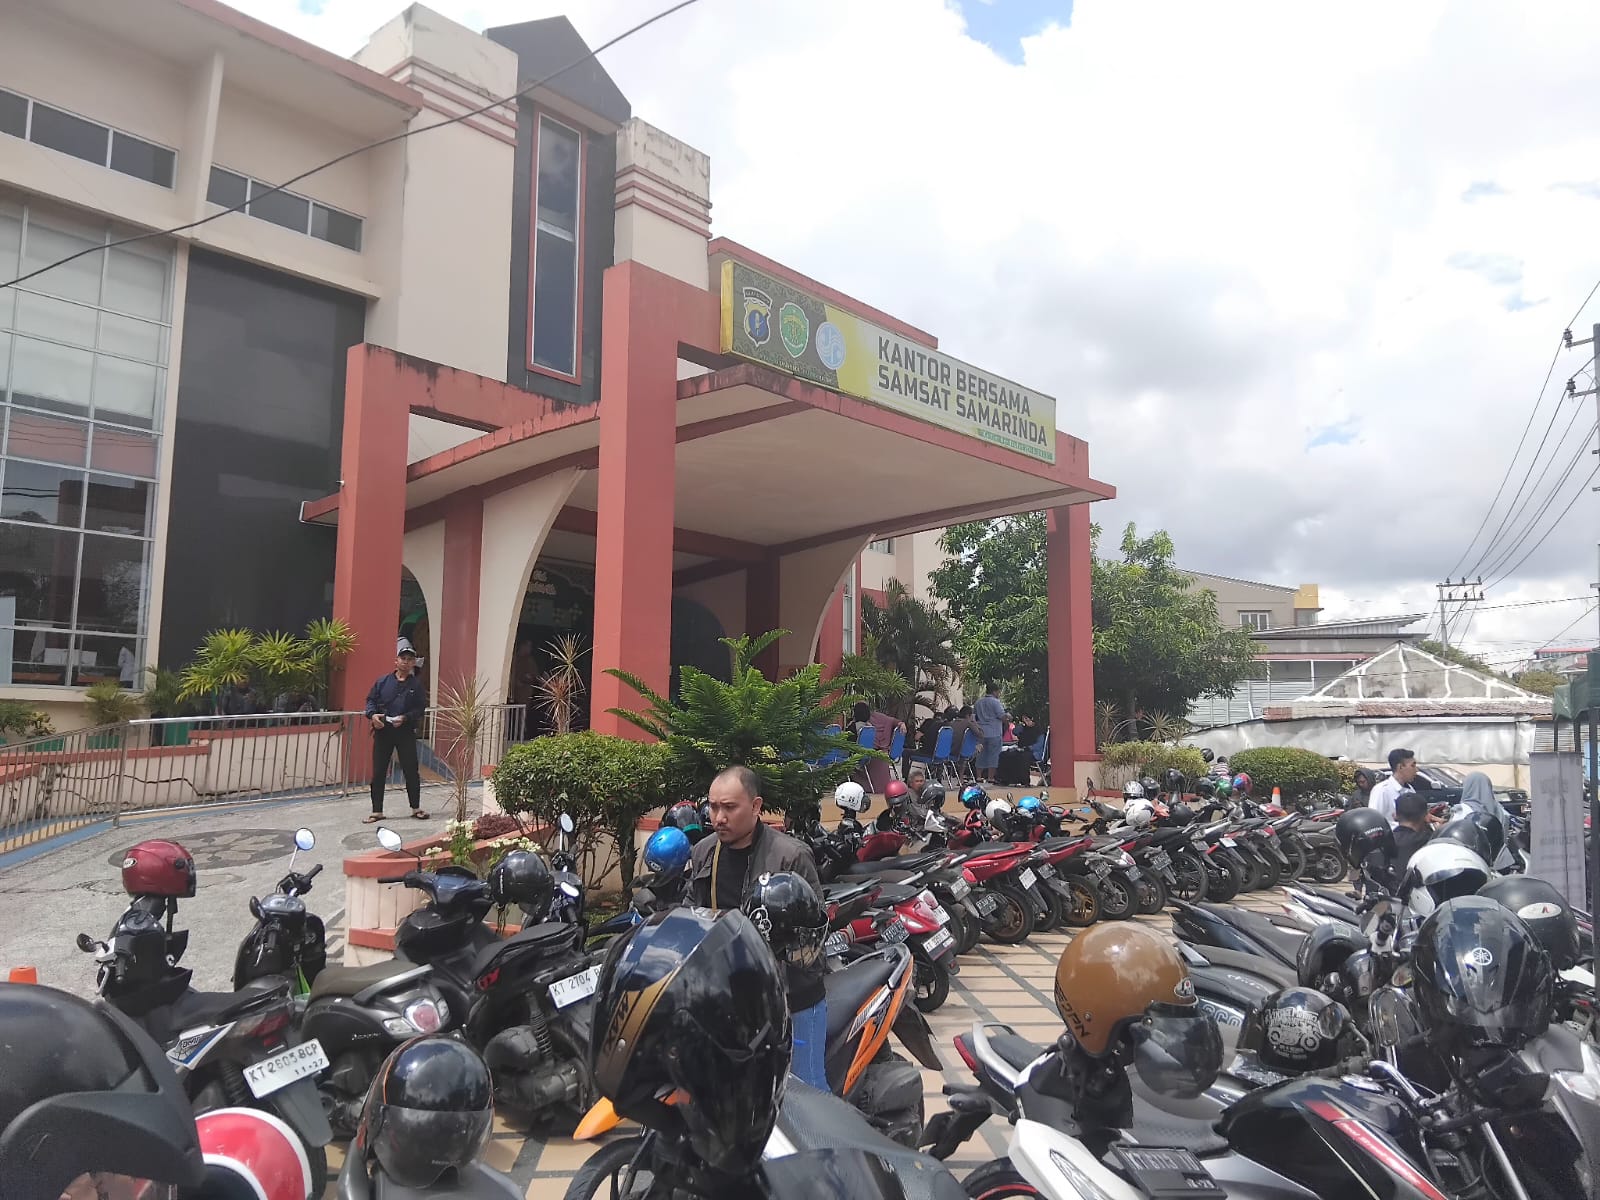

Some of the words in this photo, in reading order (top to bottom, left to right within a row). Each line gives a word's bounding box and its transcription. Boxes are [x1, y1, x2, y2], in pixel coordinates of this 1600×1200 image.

[878, 335, 951, 387] KANTOR
[956, 367, 1031, 417] BERSAMA
[878, 364, 951, 411] SAMSAT
[956, 393, 1048, 447] SAMARINDA
[551, 981, 566, 996] KT
[568, 971, 591, 990] 2704
[248, 1066, 266, 1082] KT
